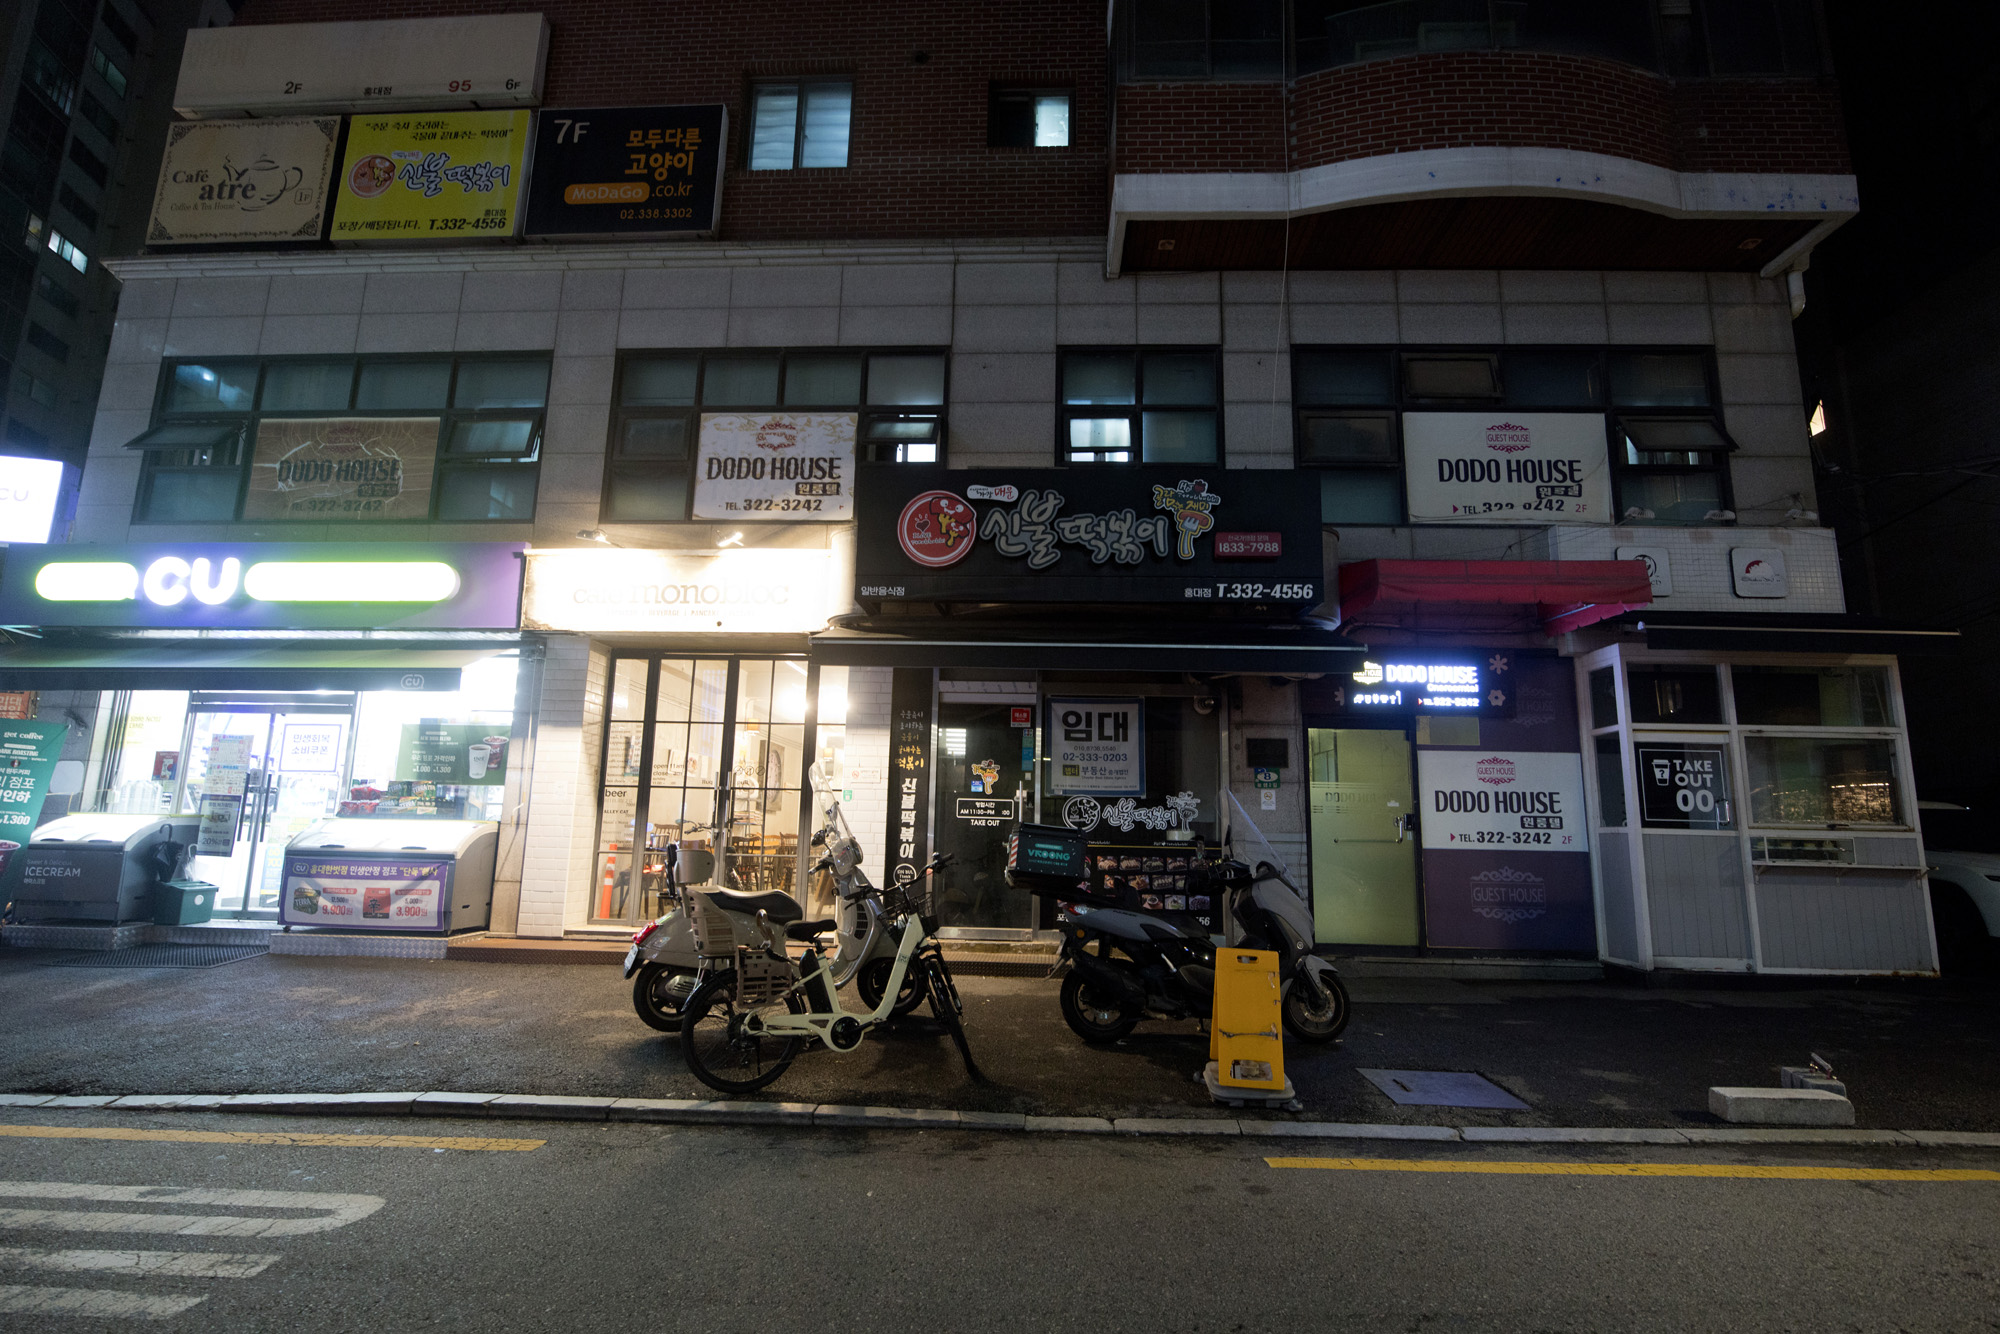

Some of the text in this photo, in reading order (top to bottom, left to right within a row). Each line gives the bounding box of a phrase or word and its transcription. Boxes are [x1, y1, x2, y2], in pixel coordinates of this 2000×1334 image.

[284, 81, 303, 95] 2F
[363, 85, 393, 97] 홍대점
[448, 79, 472, 93] 95
[505, 78, 521, 91] 6F
[553, 119, 591, 144] 7F
[624, 128, 703, 150] 모두다른
[624, 151, 695, 181] 고양이
[172, 169, 209, 184] Café
[198, 178, 257, 201] atre
[571, 186, 643, 200] MoDaGo
[484, 209, 507, 218] 홍대점
[619, 207, 693, 220] 02.338.3302
[428, 216, 507, 231] T.332-4556
[1487, 433, 1530, 443] GUEST HOUSE
[277, 458, 401, 482] DODO HOUSE
[706, 456, 842, 480] DODO HOUSE
[1437, 458, 1584, 484] DODO HOUSE
[724, 499, 823, 511] TEL. 322-3242
[1575, 503, 1587, 513] 2F
[1218, 542, 1279, 553] 1833-7988
[143, 555, 241, 607] CU
[860, 586, 905, 596] 일반음식점
[1184, 587, 1212, 598] 홍대점
[1216, 583, 1314, 599] T.332-4556
[1385, 664, 1427, 683] DODO
[1428, 665, 1479, 684] HOUSE
[405, 677, 421, 687] CU
[1061, 710, 1129, 742] 임대
[19, 732, 44, 741] coffee
[293, 734, 331, 744] 민생회복
[291, 745, 329, 755] 소비쿠폰
[1062, 752, 1128, 762] 02-333-0203
[1081, 766, 1107, 776] 부동산
[1477, 766, 1515, 776] GUEST HOUSE
[1672, 759, 1713, 772] TAKE
[9, 776, 36, 790] 점포
[1263, 772, 1272, 781] 8
[1674, 772, 1714, 788] OUT
[604, 789, 628, 798] beer
[1434, 790, 1562, 814] DODO HOUSE
[1675, 788, 1715, 813] 00
[970, 819, 1001, 827] TAKE OUT
[1458, 831, 1573, 845] TEL. 322-3242 2F
[1027, 848, 1071, 862] VROONG
[25, 866, 81, 877] ICECREAM
[381, 866, 398, 877] 점포
[1472, 886, 1544, 903] GUEST HOUSE
